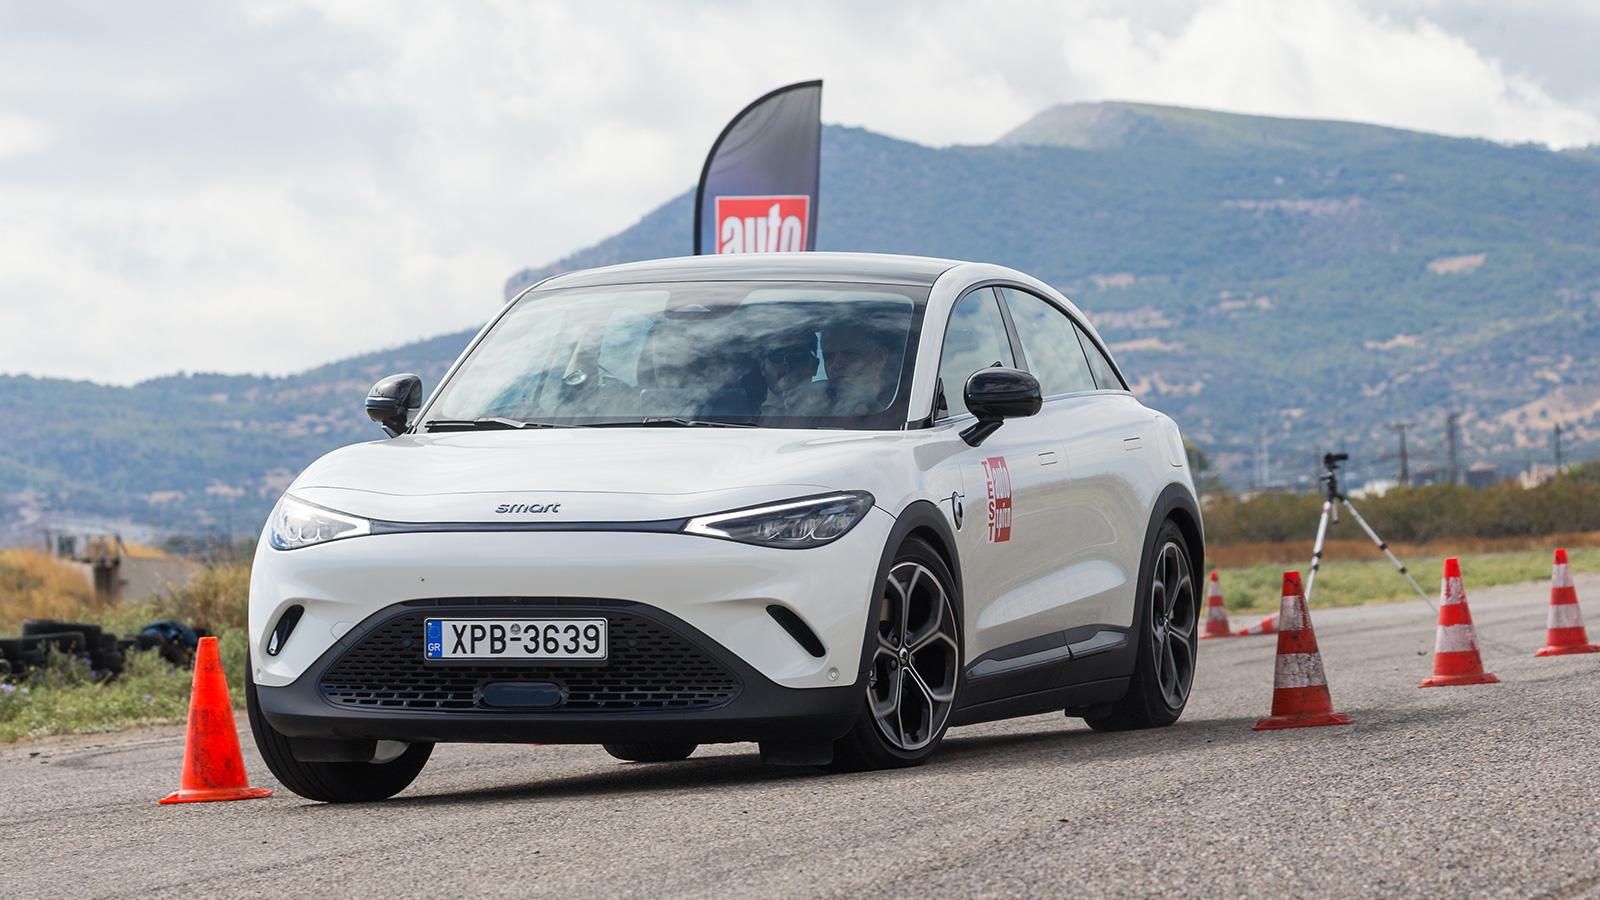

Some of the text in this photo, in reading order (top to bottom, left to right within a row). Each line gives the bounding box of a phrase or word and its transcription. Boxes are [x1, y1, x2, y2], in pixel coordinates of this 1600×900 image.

[721, 202, 802, 254] auto
[992, 460, 1011, 500] auto
[495, 502, 561, 513] smart
[981, 461, 994, 541] TEST
[428, 643, 441, 651] GR
